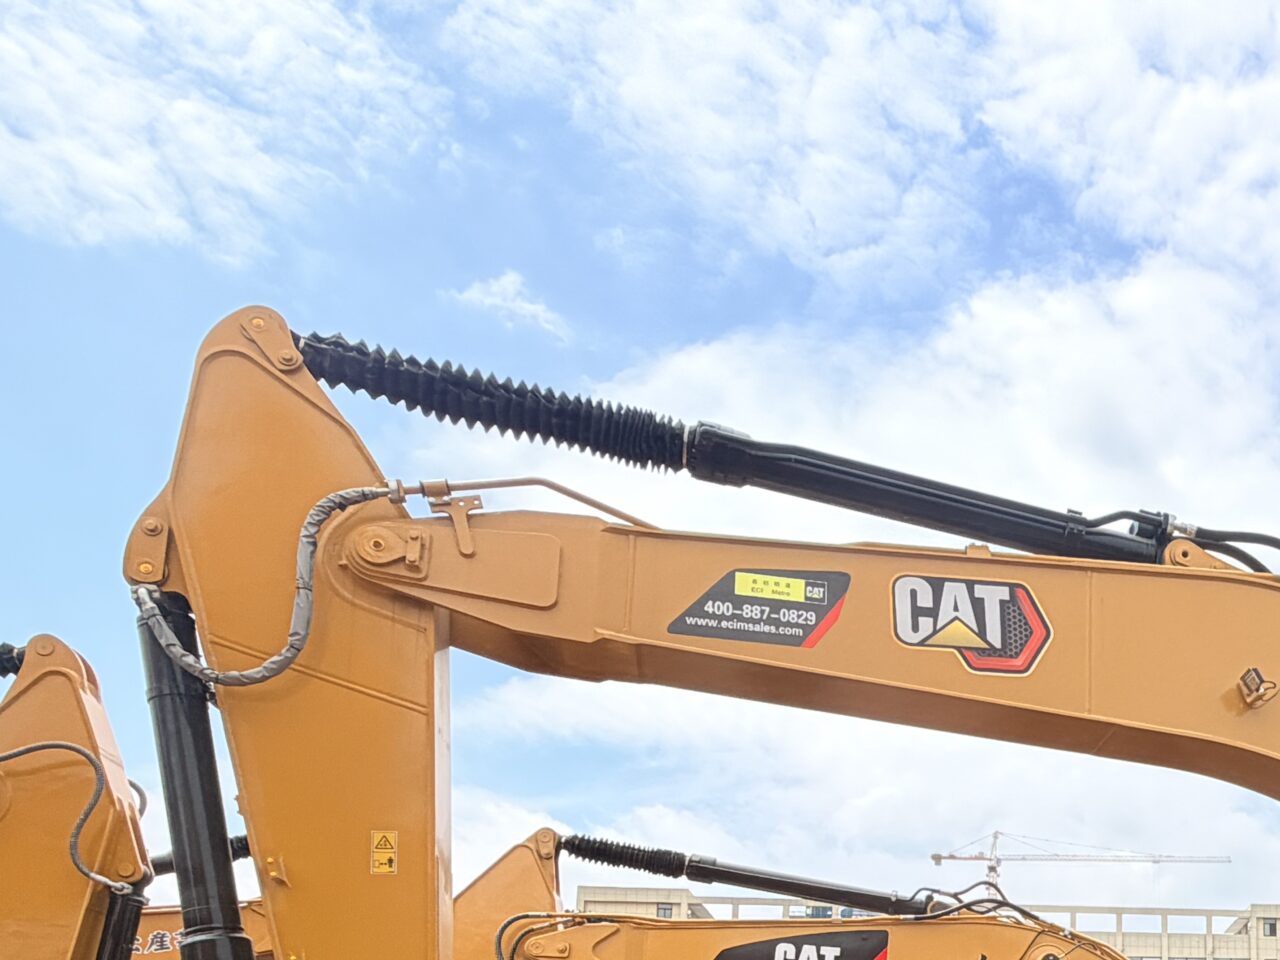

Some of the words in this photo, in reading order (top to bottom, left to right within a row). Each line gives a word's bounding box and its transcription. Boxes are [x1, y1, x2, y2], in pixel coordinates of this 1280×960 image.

[806, 586, 825, 599] CAT
[704, 600, 816, 626] 400-887-0829
[894, 576, 1010, 649] CAT
[685, 616, 803, 637] www.ecimsales.com
